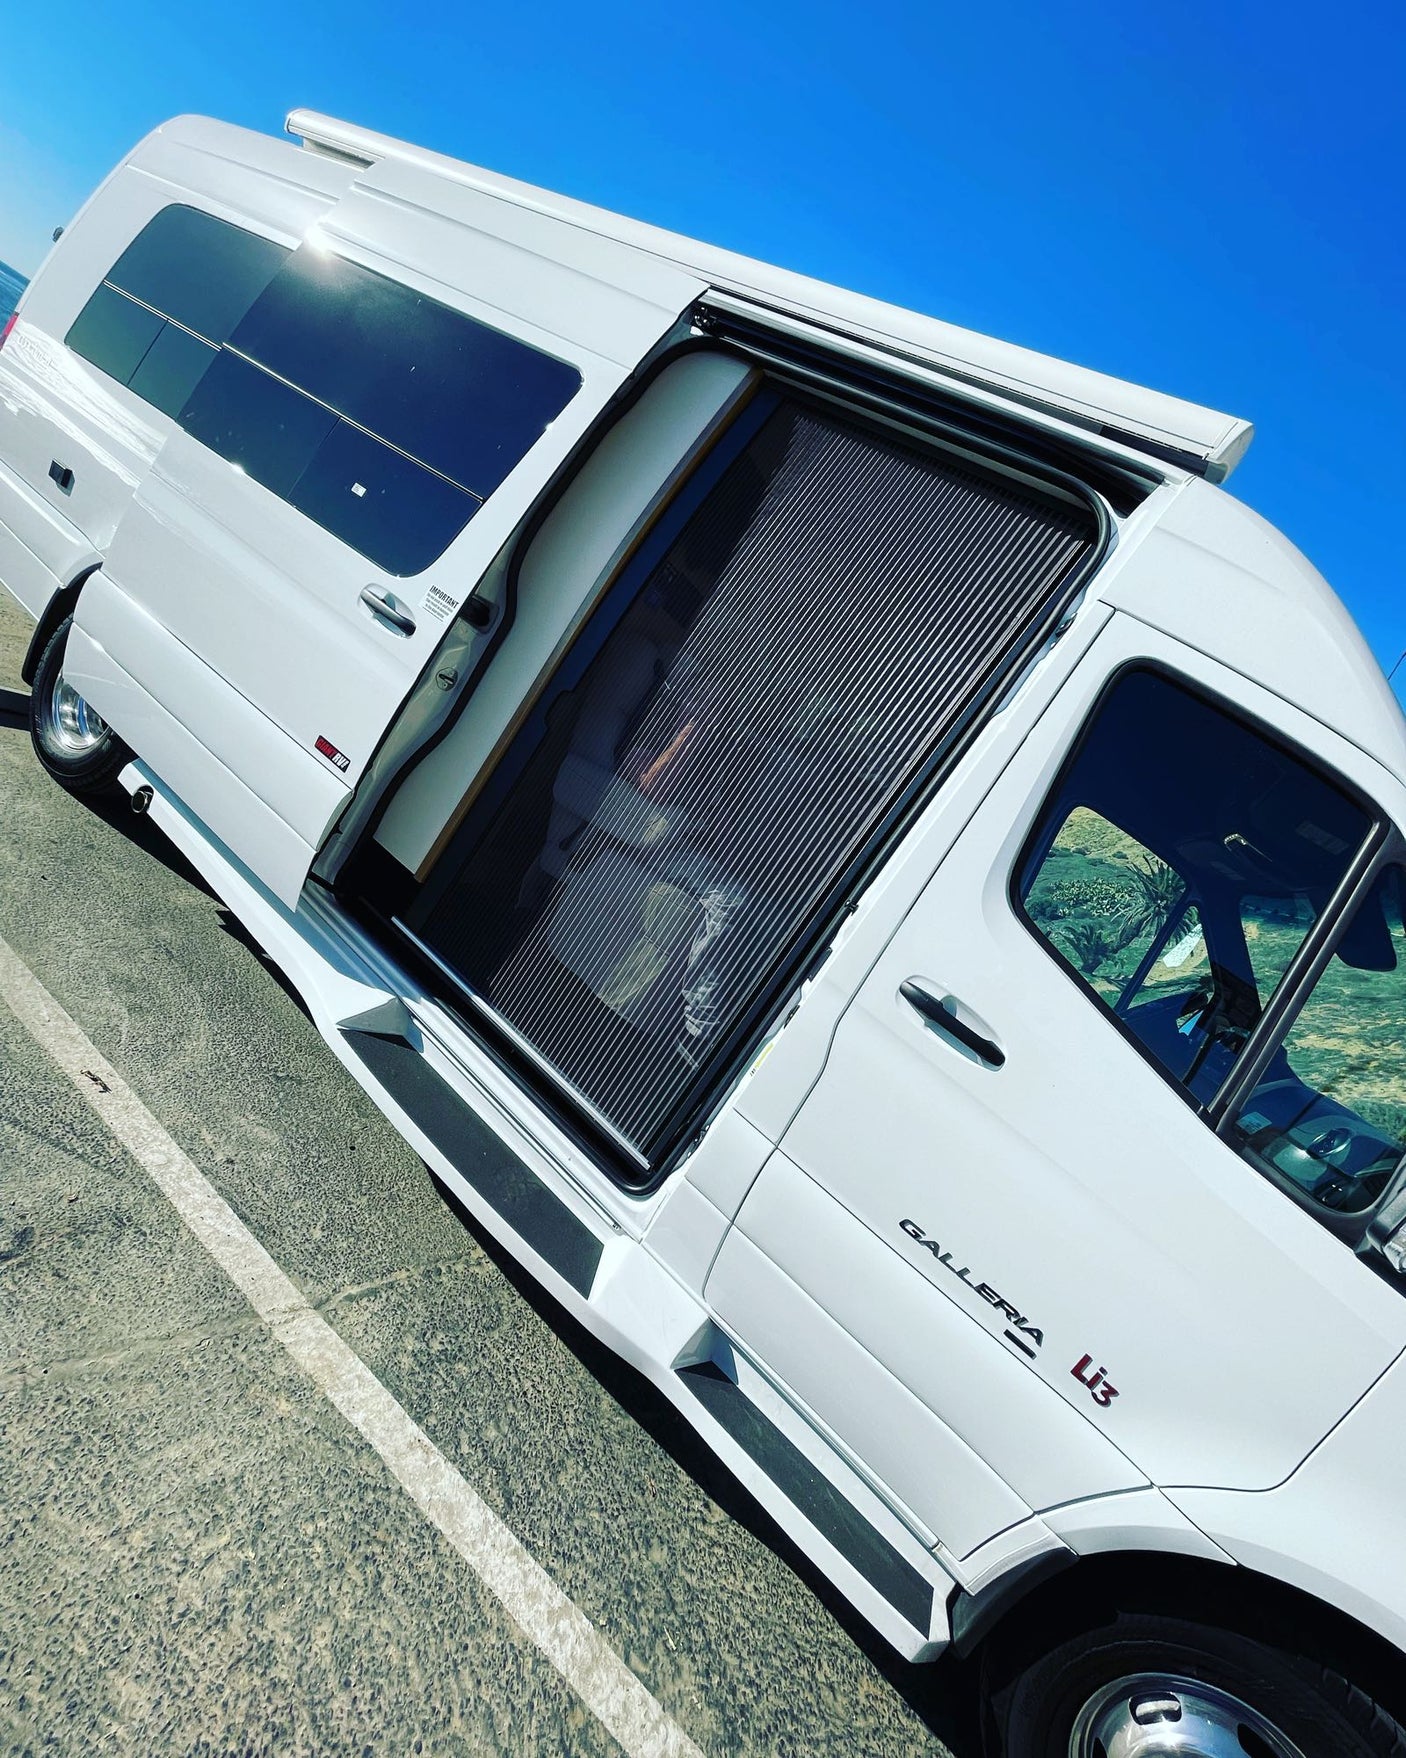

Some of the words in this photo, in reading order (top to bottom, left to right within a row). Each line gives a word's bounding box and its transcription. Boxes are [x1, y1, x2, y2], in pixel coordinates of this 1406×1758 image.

[429, 585, 459, 609] IMPORTANT
[316, 738, 337, 758] GIANT
[899, 1219, 1044, 1347] GALLERIA
[1070, 1353, 1120, 1408] Li3
